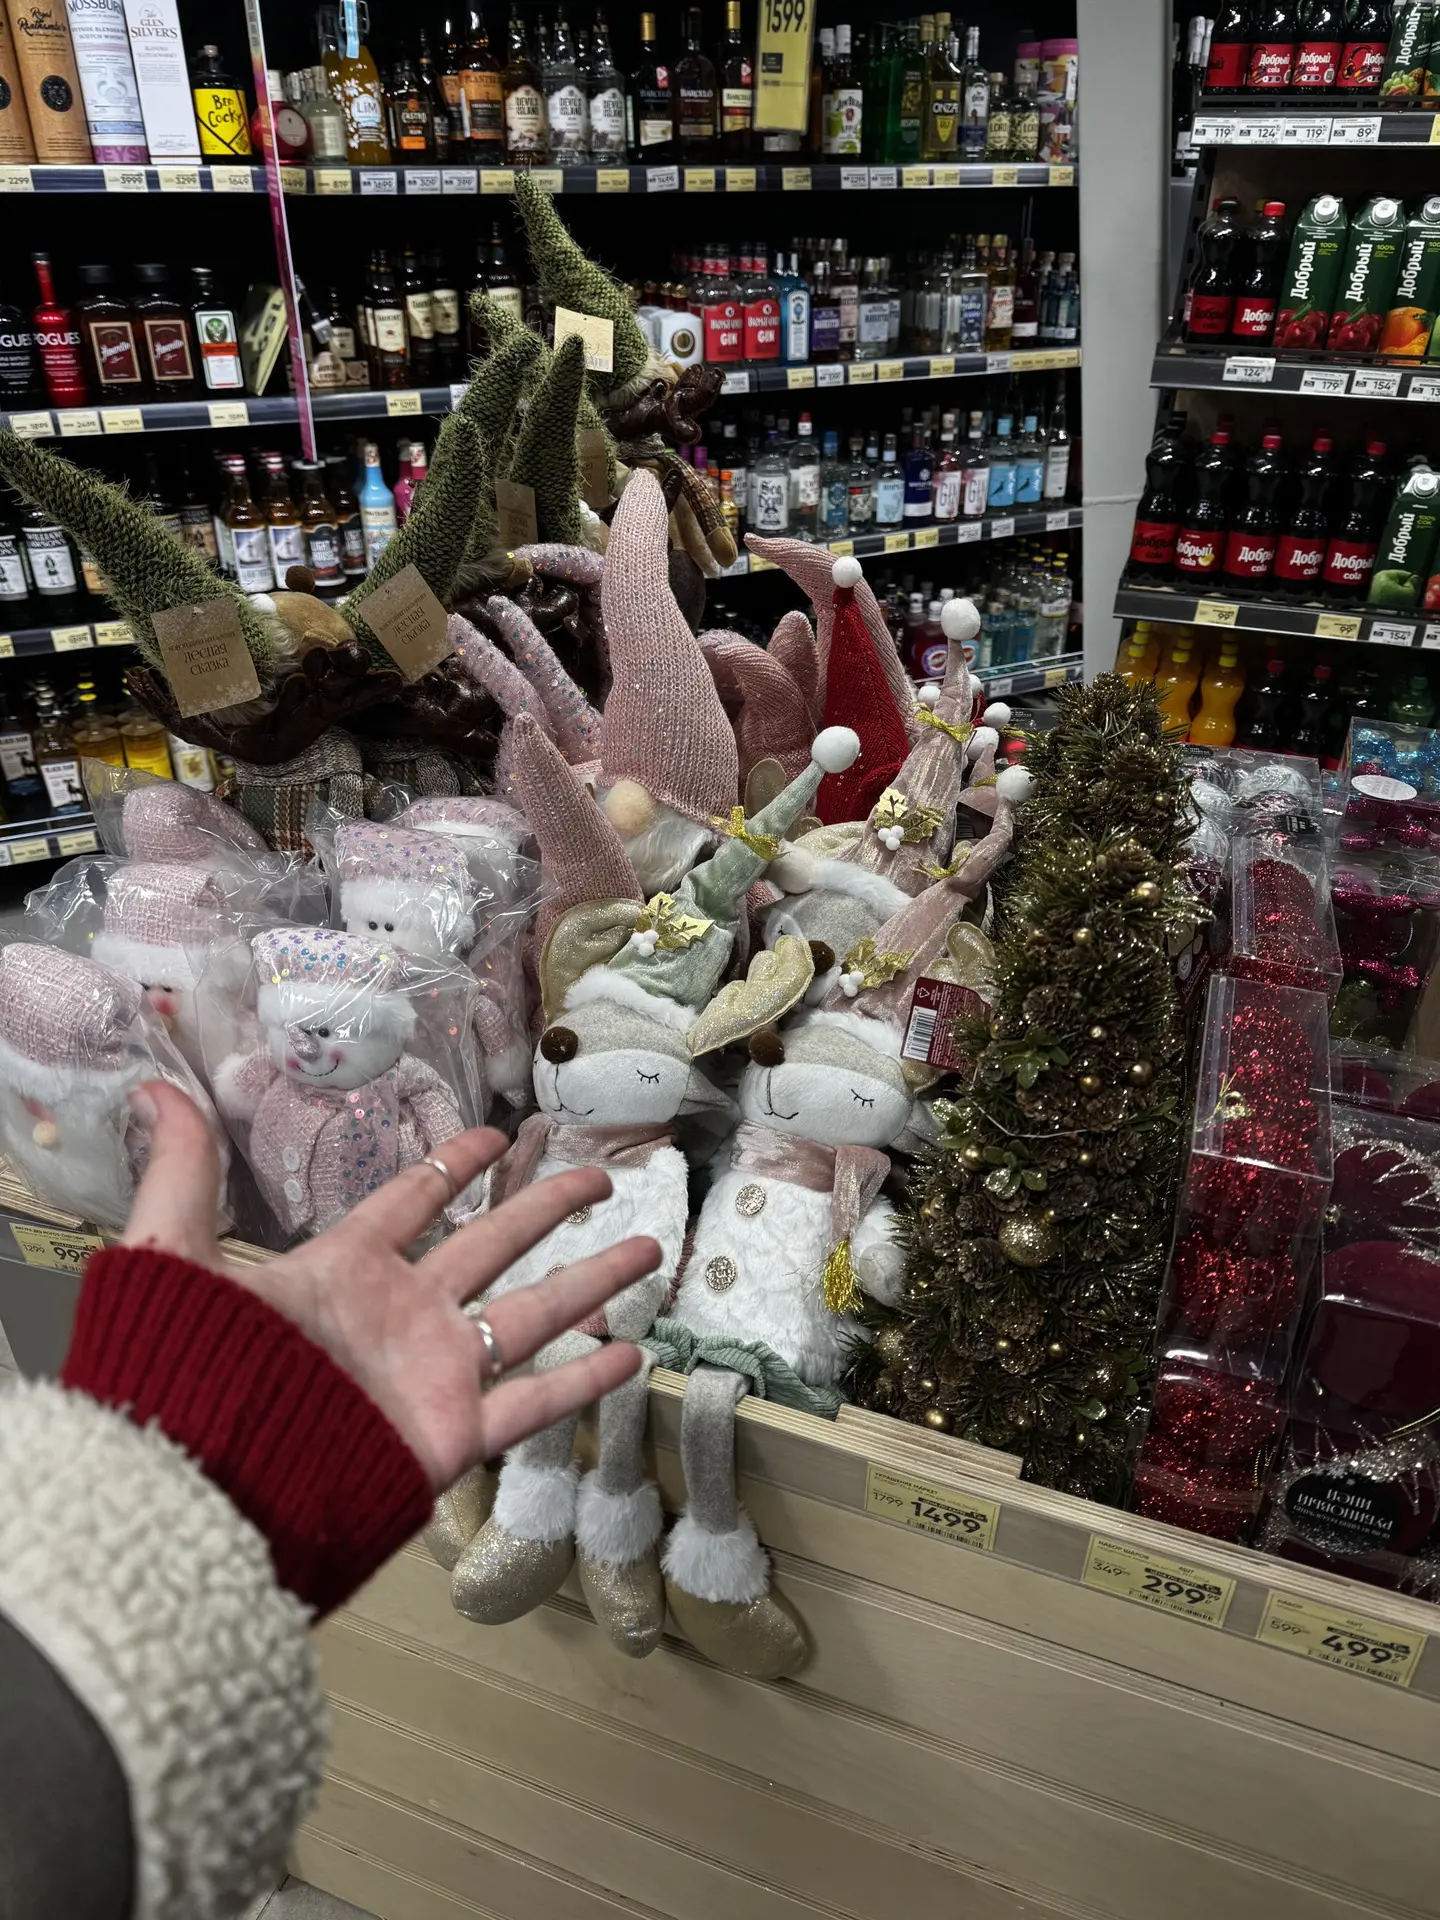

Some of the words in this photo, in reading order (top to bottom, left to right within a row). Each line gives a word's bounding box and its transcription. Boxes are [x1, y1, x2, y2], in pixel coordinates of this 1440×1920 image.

[766, 0, 805, 33] 1599
[1395, 9, 1422, 65] Добрый
[1258, 53, 1290, 66] Добрый
[1299, 51, 1331, 66] Добрый
[1306, 65, 1319, 73] cola
[207, 108, 244, 129] Cocky
[1215, 128, 1230, 138] 119
[1257, 128, 1275, 138] 124
[1306, 128, 1322, 138] 119
[1357, 128, 1371, 138] 89
[8, 177, 29, 185] 2299
[120, 175, 143, 184] 3999
[175, 176, 197, 184] 3299
[1319, 242, 1339, 250] 100%
[1289, 240, 1316, 300] Добрый
[1345, 243, 1373, 303] Добрый
[1397, 240, 1426, 300] Добрый
[720, 332, 738, 346] GIN
[757, 329, 775, 343] GIN
[1244, 368, 1261, 377] 124
[1322, 380, 1338, 390] 179
[1373, 380, 1391, 390] 154
[1387, 511, 1416, 564] Добрый
[1180, 557, 1197, 567] cola
[1331, 553, 1375, 571] Добрый
[1343, 571, 1363, 581] cola
[392, 605, 425, 637] лесная
[1218, 612, 1230, 620] 99
[401, 617, 431, 645] сказка
[1340, 626, 1353, 634] 99
[1390, 632, 1406, 641] 154
[184, 643, 228, 664] лесная
[190, 657, 230, 676] сказка
[22, 1243, 46, 1254] 1299
[875, 1471, 912, 1488] УКРАШЕНИЕ
[872, 1490, 904, 1508] 1799
[910, 1501, 981, 1534] 1499
[1296, 1493, 1394, 1531] РУБИНОВЫЙ
[1098, 1540, 1123, 1551] НАБОР
[1123, 1548, 1149, 1560] ШАРОВ
[1093, 1561, 1122, 1576] 349
[1141, 1574, 1206, 1605] 299
[1277, 1598, 1303, 1610] НАБОР
[1270, 1619, 1302, 1636] 599
[1321, 1638, 1393, 1664] 499
